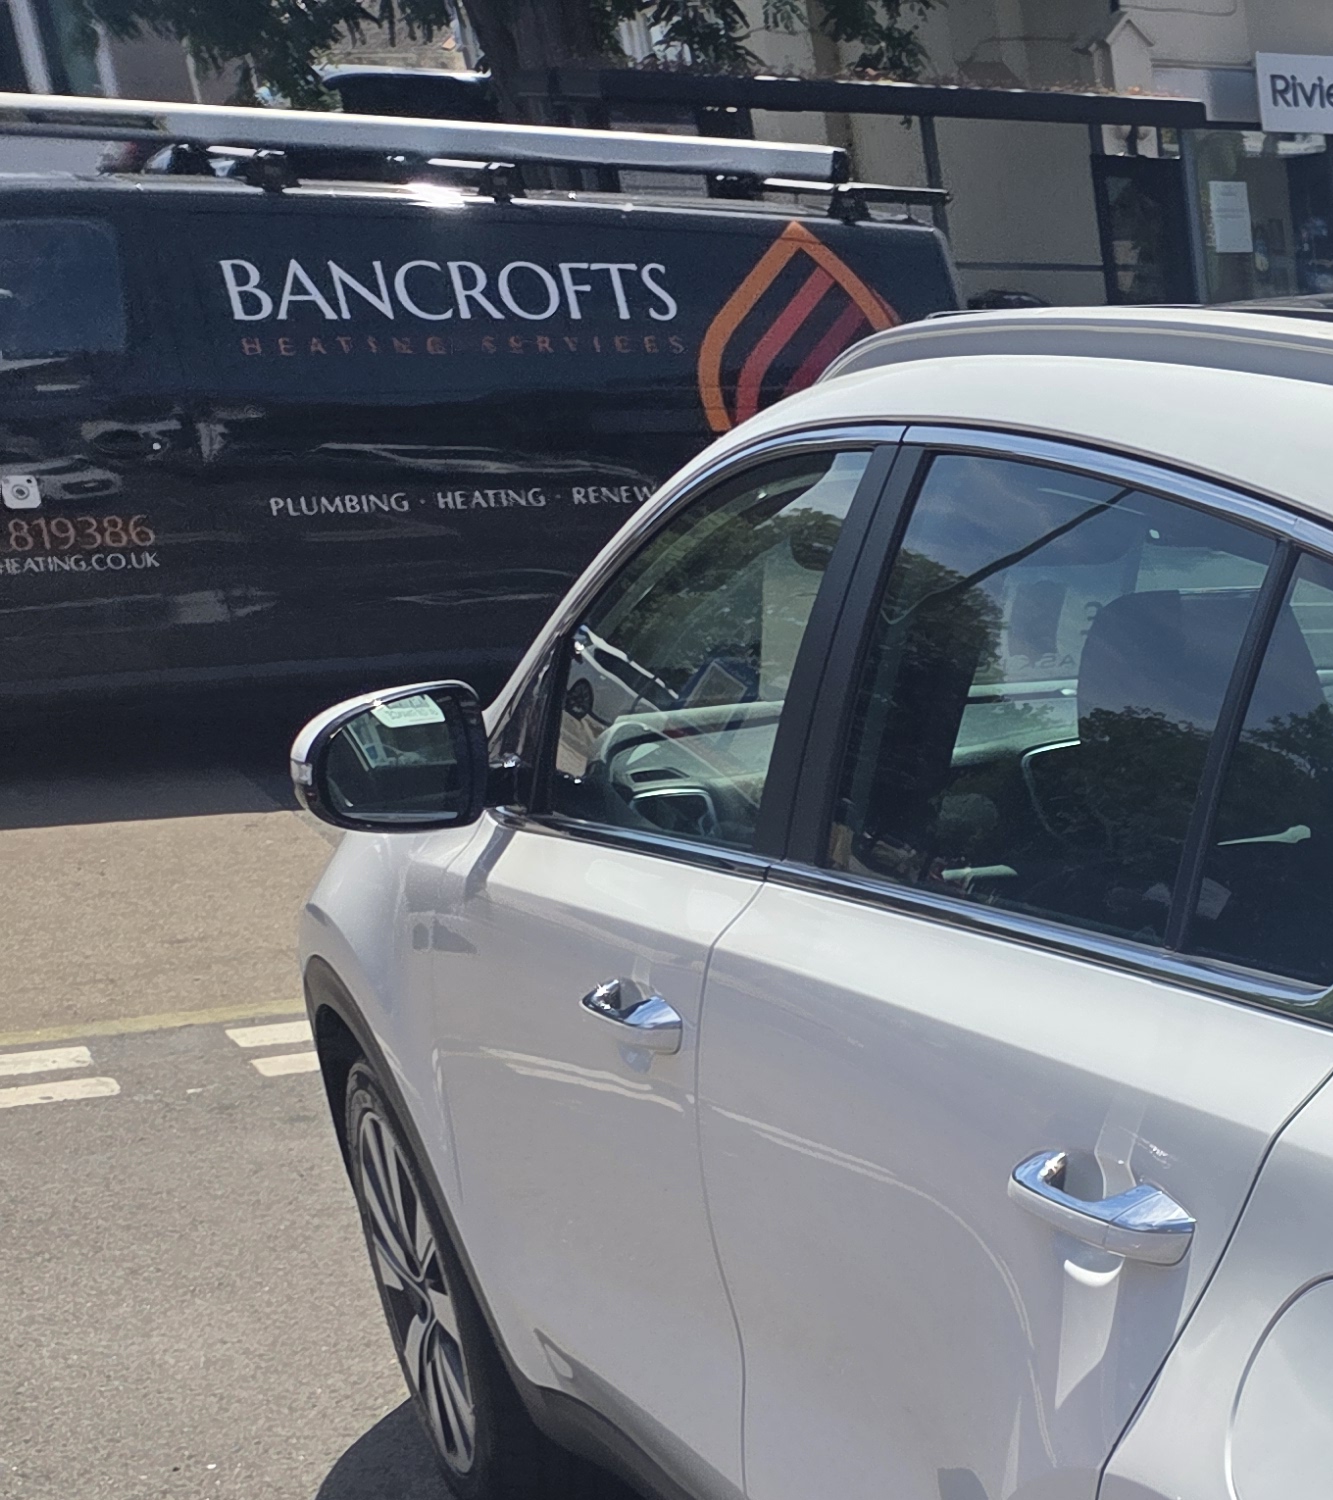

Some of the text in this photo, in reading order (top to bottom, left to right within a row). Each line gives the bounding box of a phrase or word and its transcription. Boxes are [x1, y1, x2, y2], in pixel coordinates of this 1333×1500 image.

[219, 258, 678, 322] BANCROFTS
[241, 335, 685, 355] HEATING SERVICES
[270, 492, 409, 517] PLUMBING
[437, 488, 546, 510] HEATING
[8, 514, 155, 551] 819386
